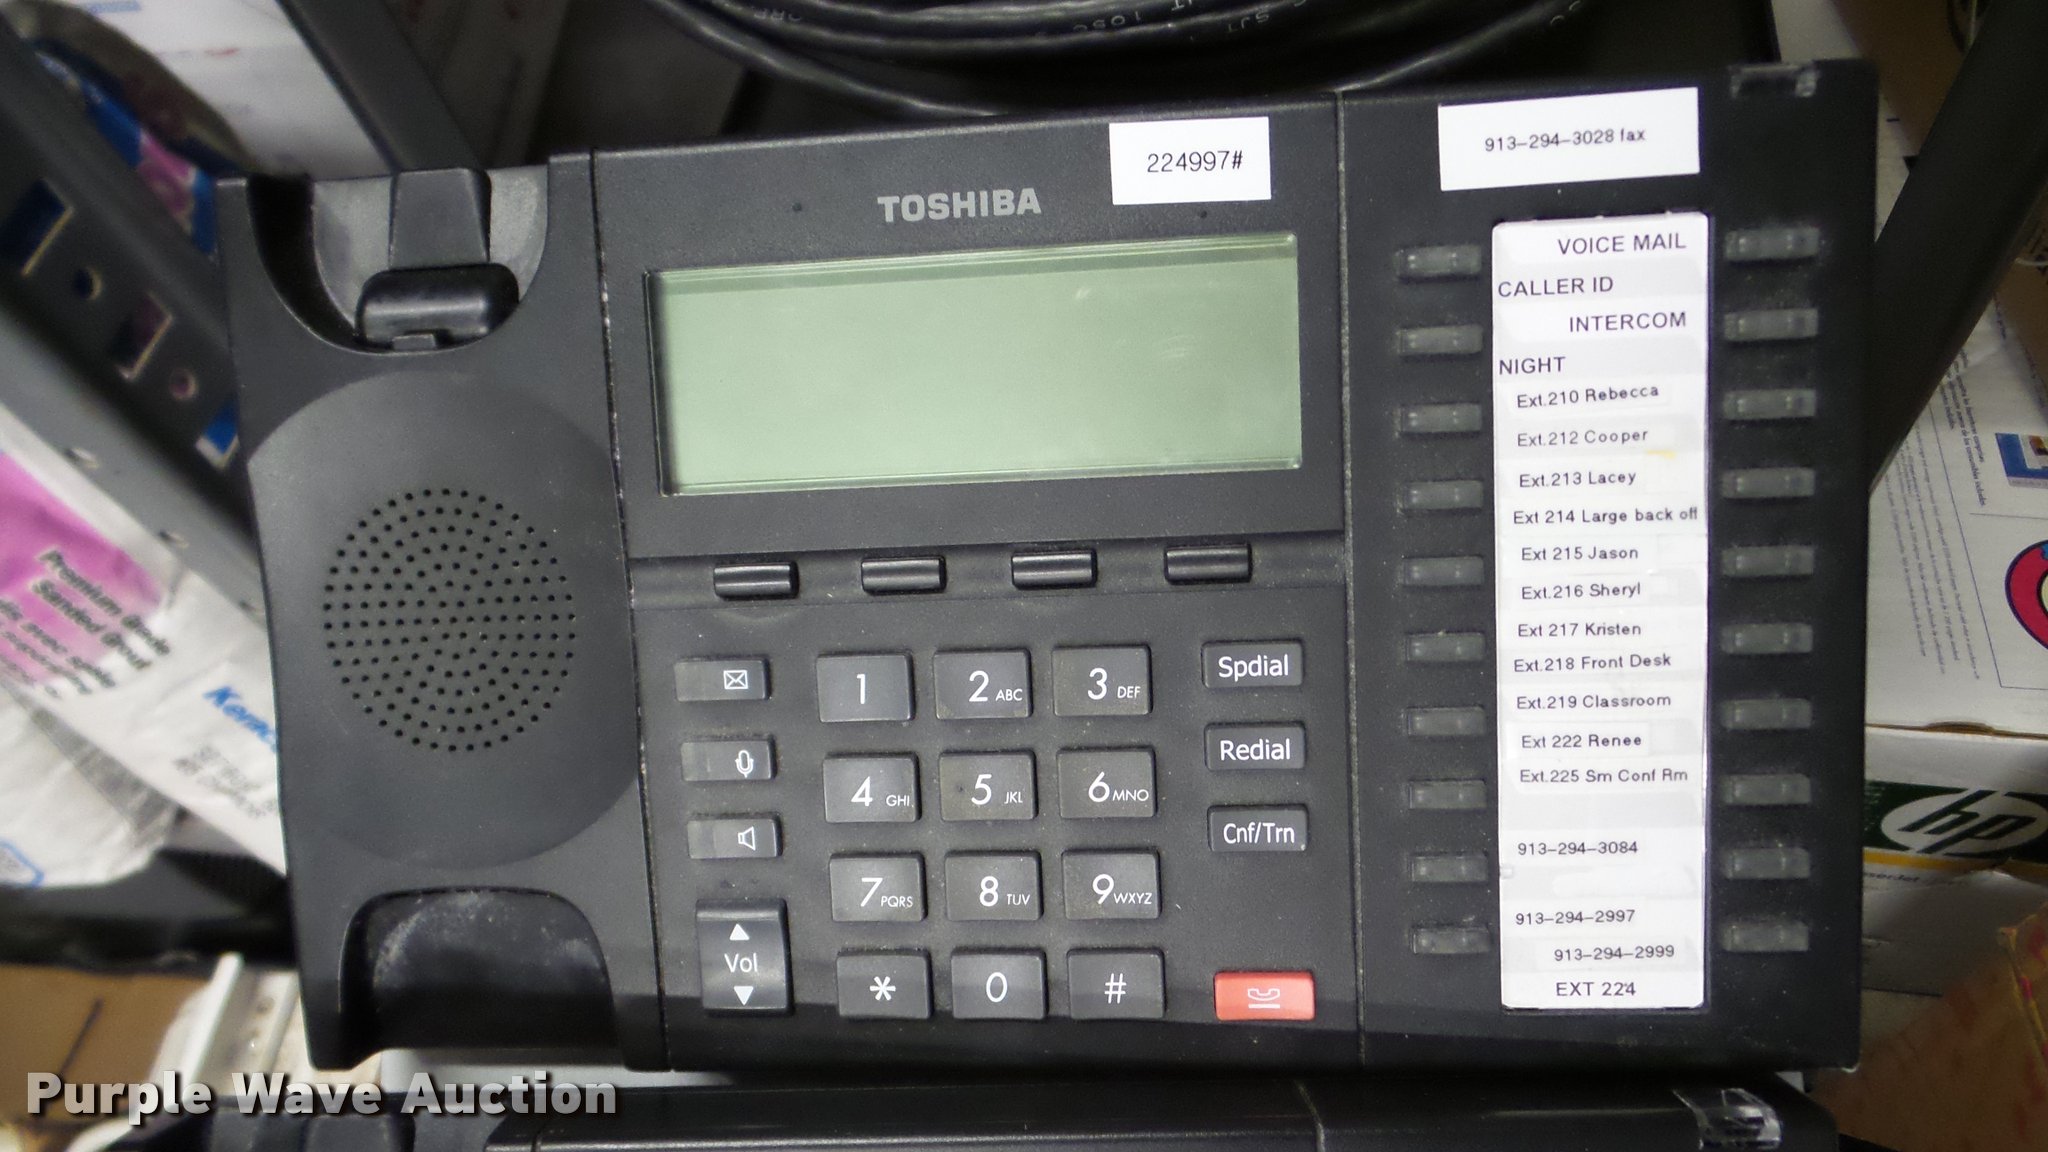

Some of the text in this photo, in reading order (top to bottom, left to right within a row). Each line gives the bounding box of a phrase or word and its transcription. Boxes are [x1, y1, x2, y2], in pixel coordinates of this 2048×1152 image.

[1485, 127, 1646, 152] 913-294-3028 fax
[1146, 149, 1243, 174] 224997#
[876, 187, 1042, 223] TOSHIBA
[1557, 232, 1687, 255] VOICE MAIL
[1498, 276, 1614, 298] CALLER ID
[1569, 312, 1687, 332] INTERCOM
[1499, 357, 1566, 375] NIGHT
[1517, 386, 1659, 408] Ext.210 Rebecca
[1517, 430, 1648, 447] Ext.212 Cooper
[1519, 472, 1637, 488] Ext.213 Lacey
[1513, 506, 1698, 525] Ext 214 Large back off
[1521, 546, 1639, 561] Ext 215 Jason
[1521, 582, 1641, 600] Ext.216 Sheryl
[1517, 622, 1642, 637] Ext 217 Kristen
[1218, 654, 1290, 682] Spdial
[1513, 652, 1672, 673] Ext.218 Front Desk
[856, 673, 866, 704] 1
[968, 670, 1023, 703] 2 ABC
[1087, 668, 1141, 700] 3 DEF
[1516, 694, 1672, 710] Ext.219 Classroom
[1219, 738, 1291, 761] Redial
[1521, 734, 1642, 749] Ext 222 Renee
[1520, 768, 1688, 783] Ext.225 Sm Conf Rm
[850, 776, 910, 808] 4 GHI
[971, 773, 1023, 805] 5 JKL
[1088, 772, 1149, 802] 6 MNO
[1897, 788, 2038, 855] hp
[1223, 822, 1295, 845] Cnf/Trn
[1517, 841, 1639, 856] 913-294-3084
[860, 877, 914, 909] 7 PQRS
[979, 875, 1031, 907] 8 TUV
[1092, 873, 1153, 905] 9 WXYZ
[1515, 909, 1636, 925] 913-294-2997
[724, 953, 758, 974] Vol
[1554, 944, 1676, 962] 913-294-2999
[985, 971, 1009, 1003] 0
[1104, 973, 1128, 1004] #
[1556, 981, 1637, 997] EXT 224
